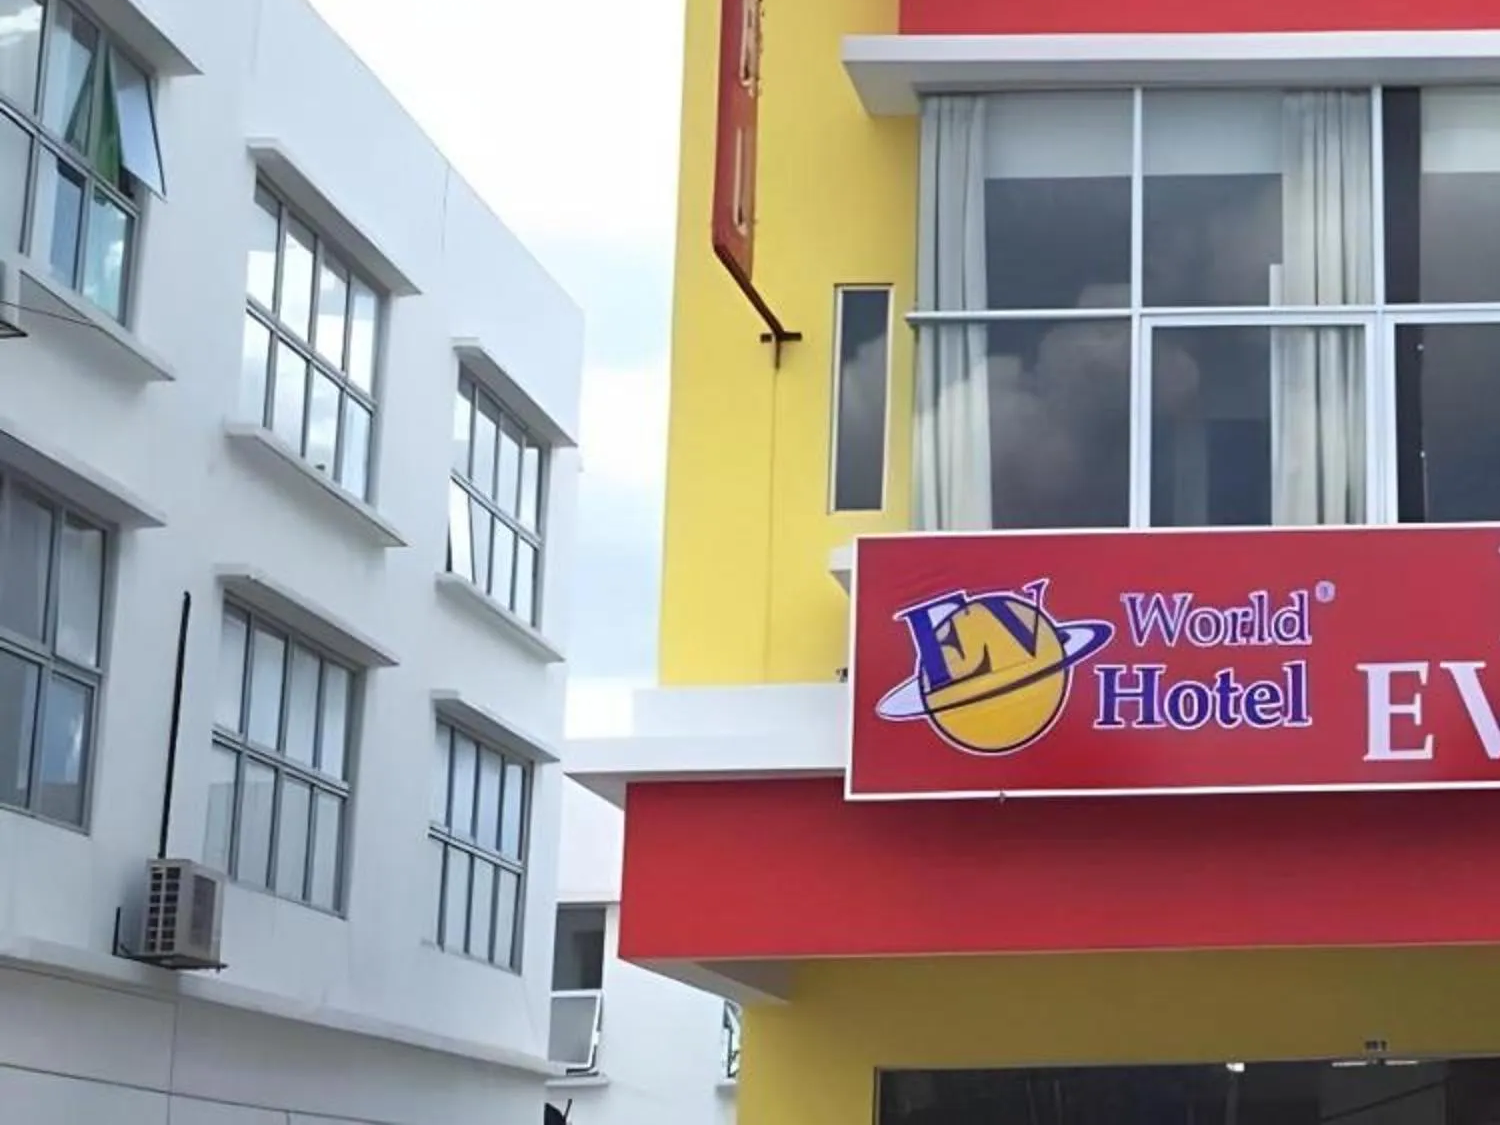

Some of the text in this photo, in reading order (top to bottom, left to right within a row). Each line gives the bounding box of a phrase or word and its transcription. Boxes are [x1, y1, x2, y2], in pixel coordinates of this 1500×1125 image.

[892, 577, 1050, 692] EV
[1119, 588, 1313, 648] World
[1092, 659, 1313, 730] Hotel
